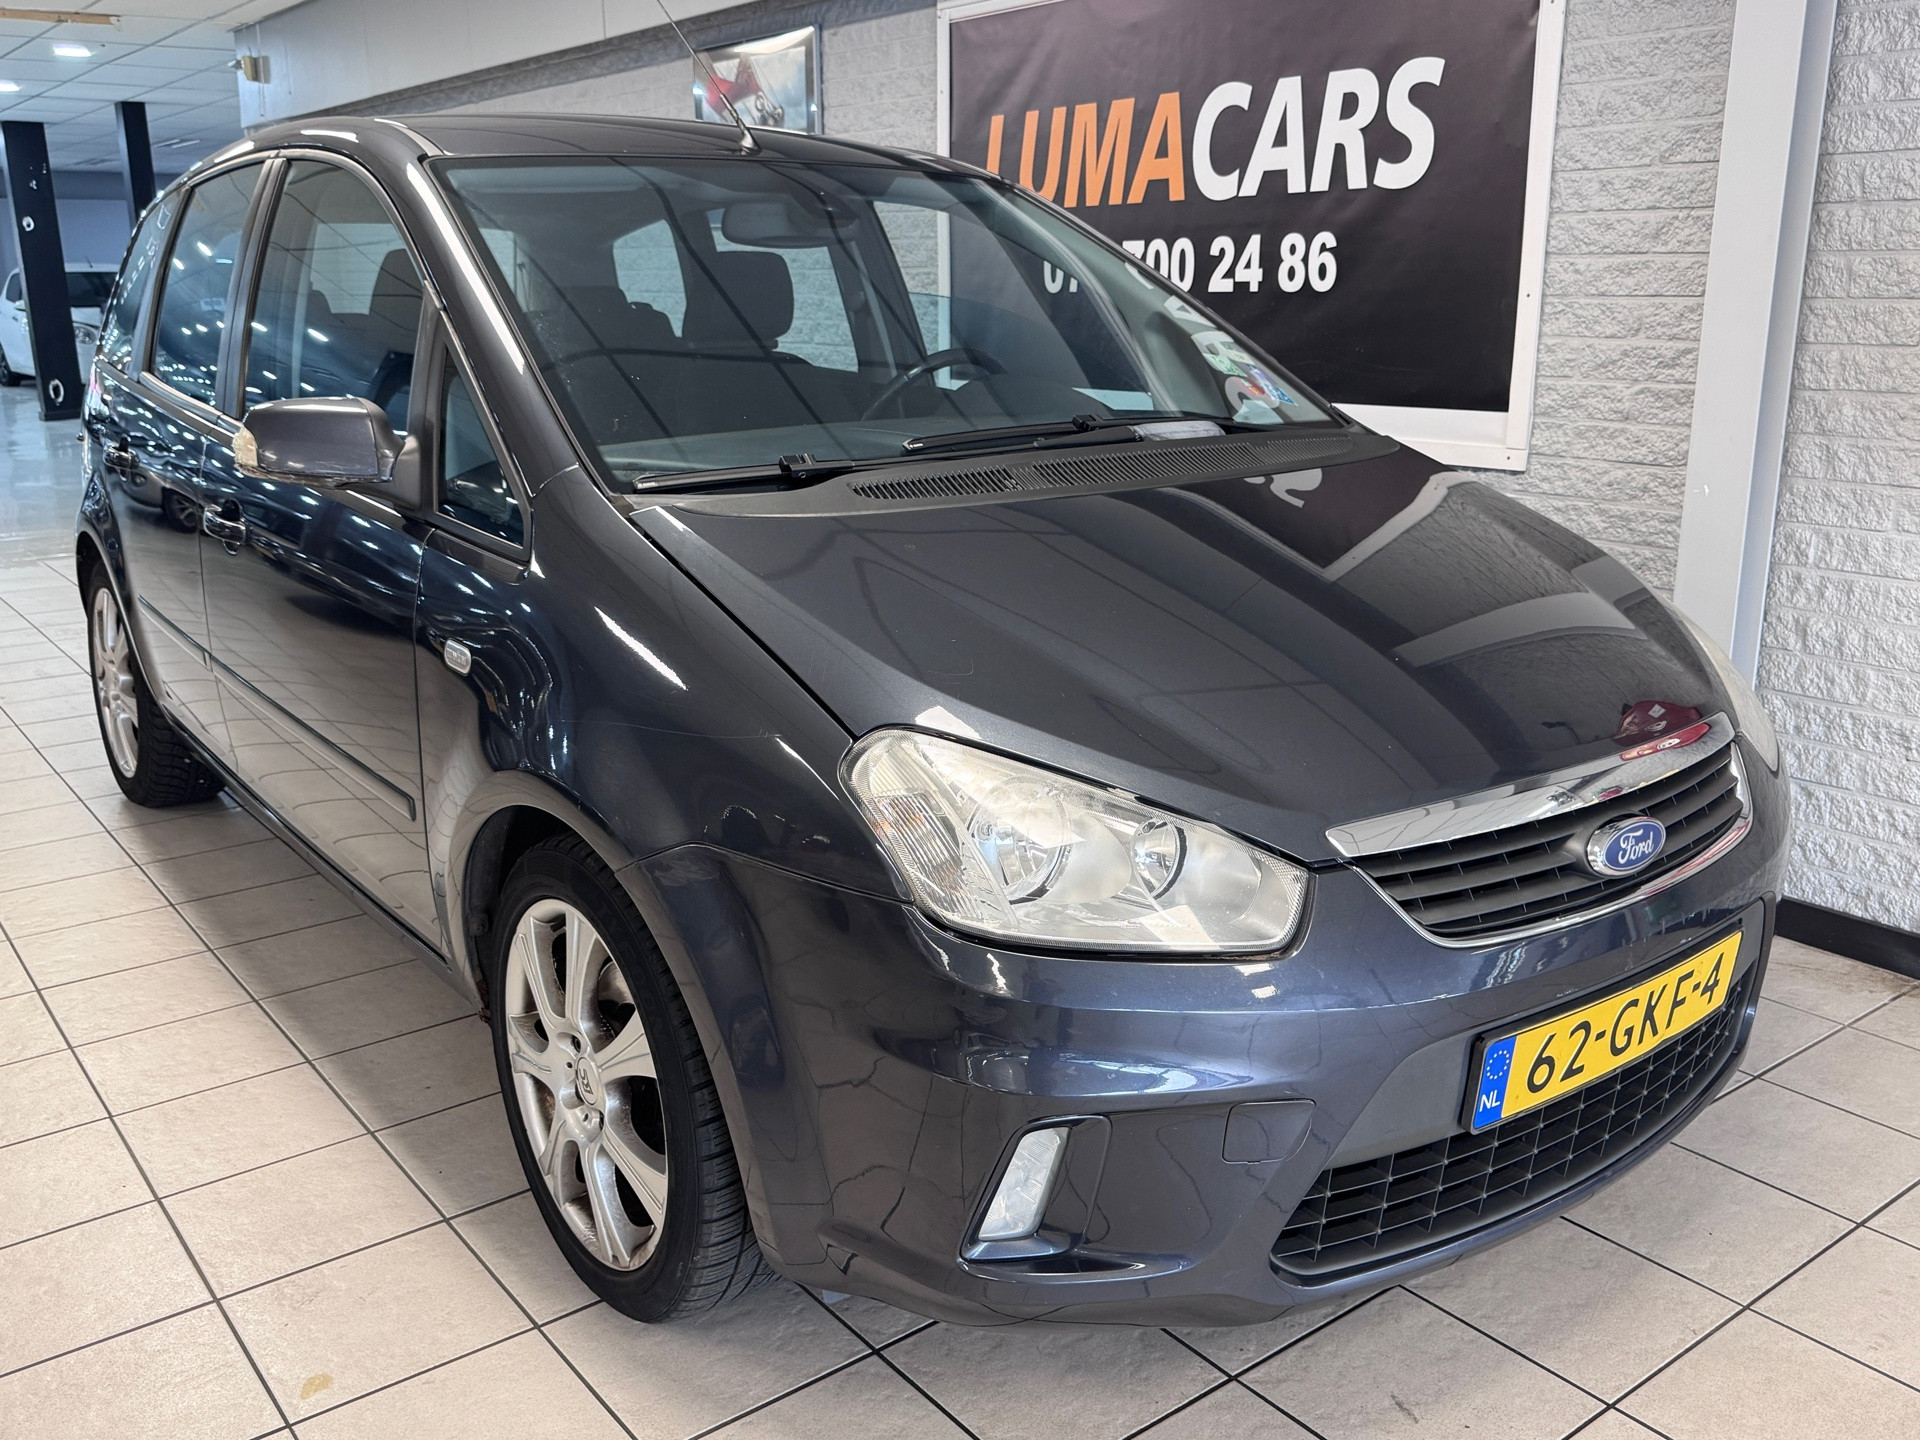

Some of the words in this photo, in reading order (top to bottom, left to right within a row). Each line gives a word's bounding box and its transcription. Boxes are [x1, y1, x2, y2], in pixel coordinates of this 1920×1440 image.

[1207, 233, 1263, 292] 24
[1277, 231, 1337, 292] 86
[1618, 828, 1654, 864] Ford
[1527, 952, 1724, 1093] 62-GKF-4
[1479, 1090, 1500, 1112] NL
